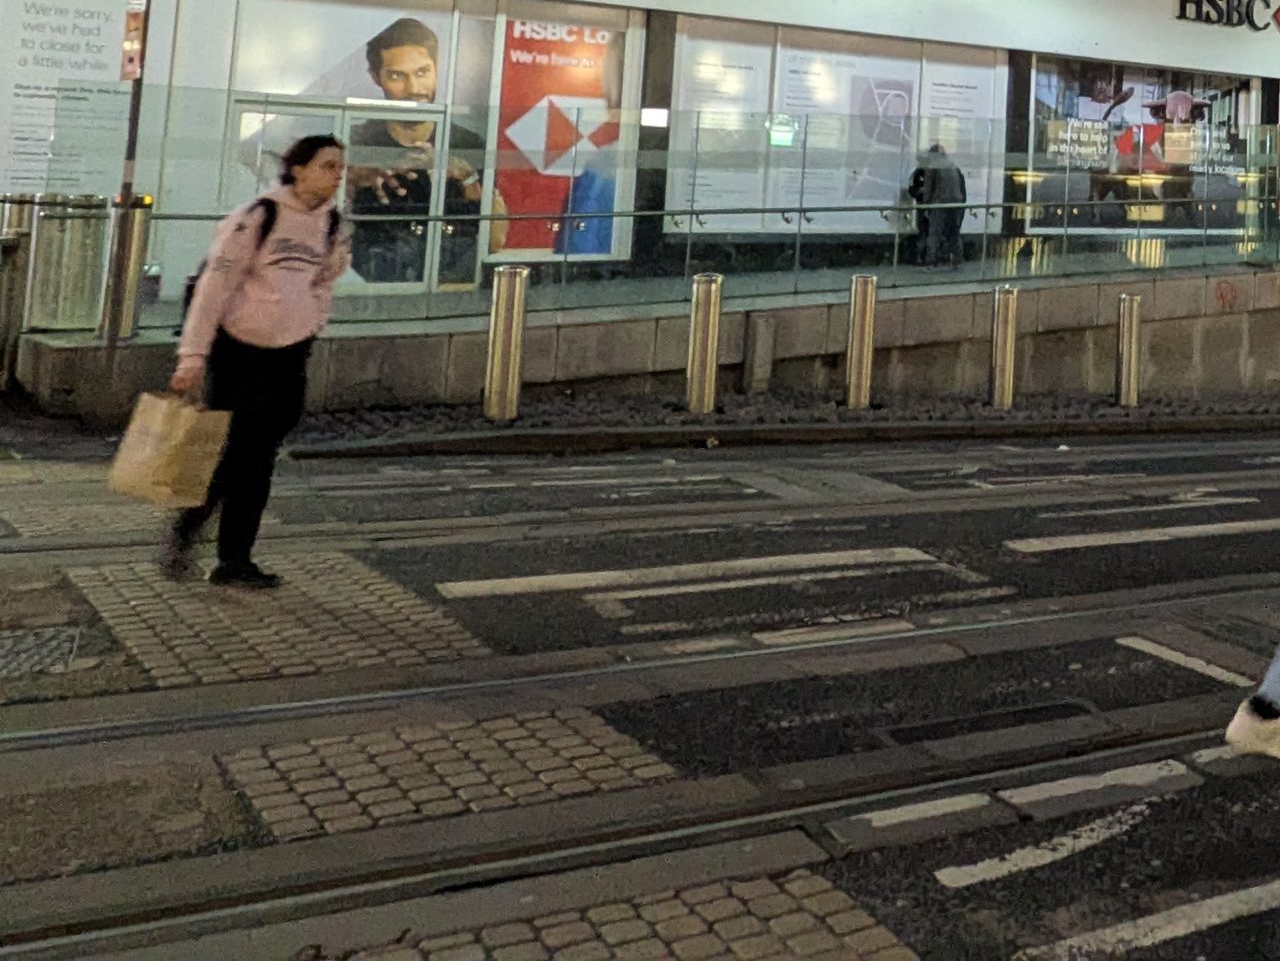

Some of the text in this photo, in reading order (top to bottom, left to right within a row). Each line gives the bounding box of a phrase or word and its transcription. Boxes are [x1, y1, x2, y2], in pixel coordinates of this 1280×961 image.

[24, 1, 69, 18] We're
[72, 23, 101, 37] had
[513, 21, 579, 43] HSBC
[20, 38, 106, 54] to close for
[18, 57, 28, 67] a
[32, 55, 64, 69] little
